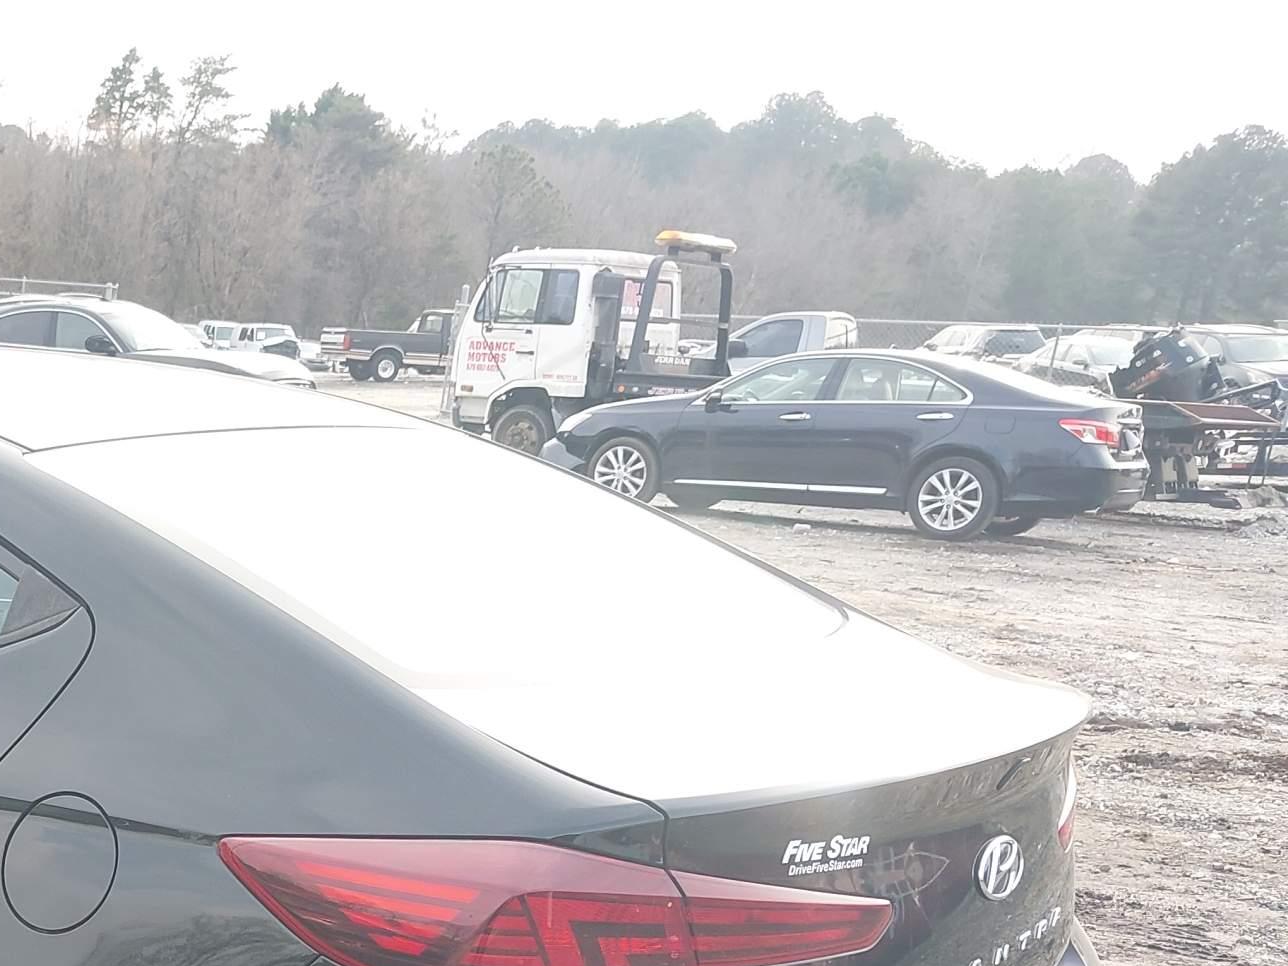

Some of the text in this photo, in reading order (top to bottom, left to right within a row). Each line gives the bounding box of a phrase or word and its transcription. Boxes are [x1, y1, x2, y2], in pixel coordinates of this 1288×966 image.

[468, 340, 516, 351] ADVANCE
[467, 351, 507, 363] MOTORS
[781, 834, 871, 865] FIVE STAR
[788, 858, 863, 876] DriveFiveStar.com
